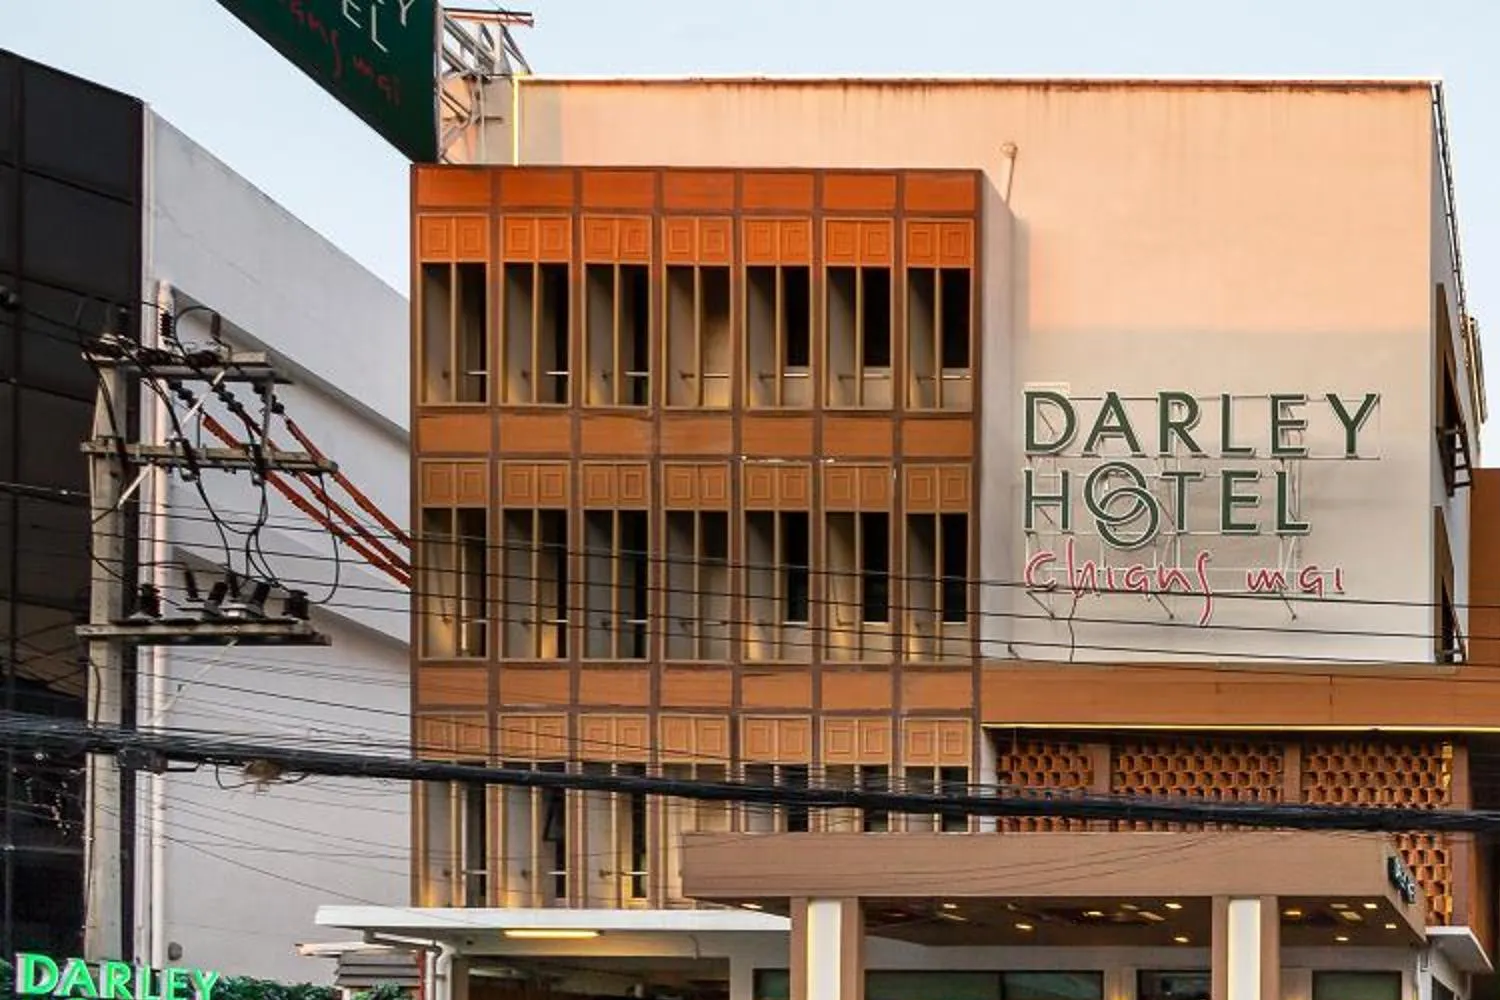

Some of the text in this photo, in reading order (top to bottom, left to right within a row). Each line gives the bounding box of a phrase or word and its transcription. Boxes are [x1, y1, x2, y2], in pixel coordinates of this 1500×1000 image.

[1024, 391, 1377, 458] DARLEY
[1024, 462, 1310, 549] HOTEL
[1247, 566, 1345, 597] mai
